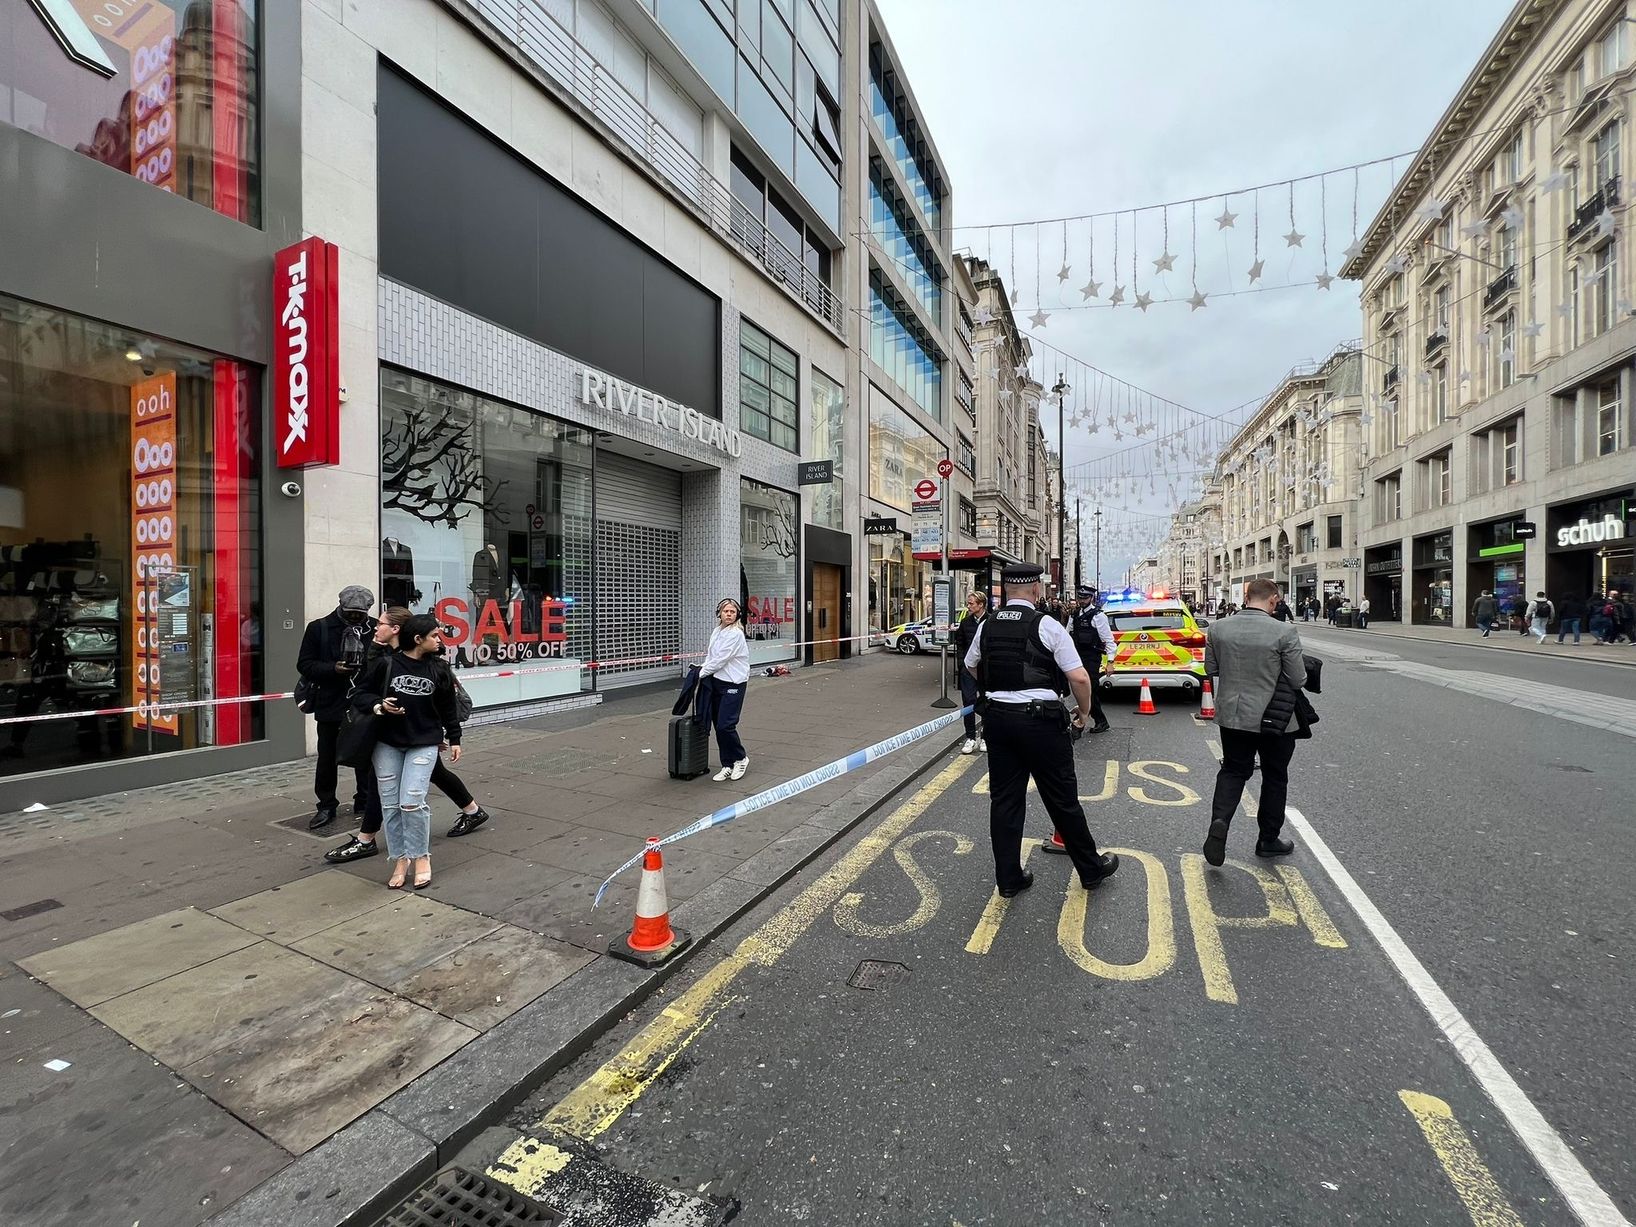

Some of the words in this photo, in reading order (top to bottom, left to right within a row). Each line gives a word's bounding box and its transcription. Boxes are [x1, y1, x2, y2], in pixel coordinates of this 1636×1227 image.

[581, 369, 670, 429] RIVER
[678, 404, 742, 459] ISLAND
[805, 471, 828, 480] ISLAND
[807, 465, 825, 473] RIVER
[885, 458, 904, 478] ZARA
[938, 464, 951, 473] OP
[1557, 513, 1625, 547] schuh
[747, 596, 794, 624] SALE
[998, 611, 1021, 620] POLICE
[434, 597, 568, 647] SALE
[497, 642, 533, 660] 50%
